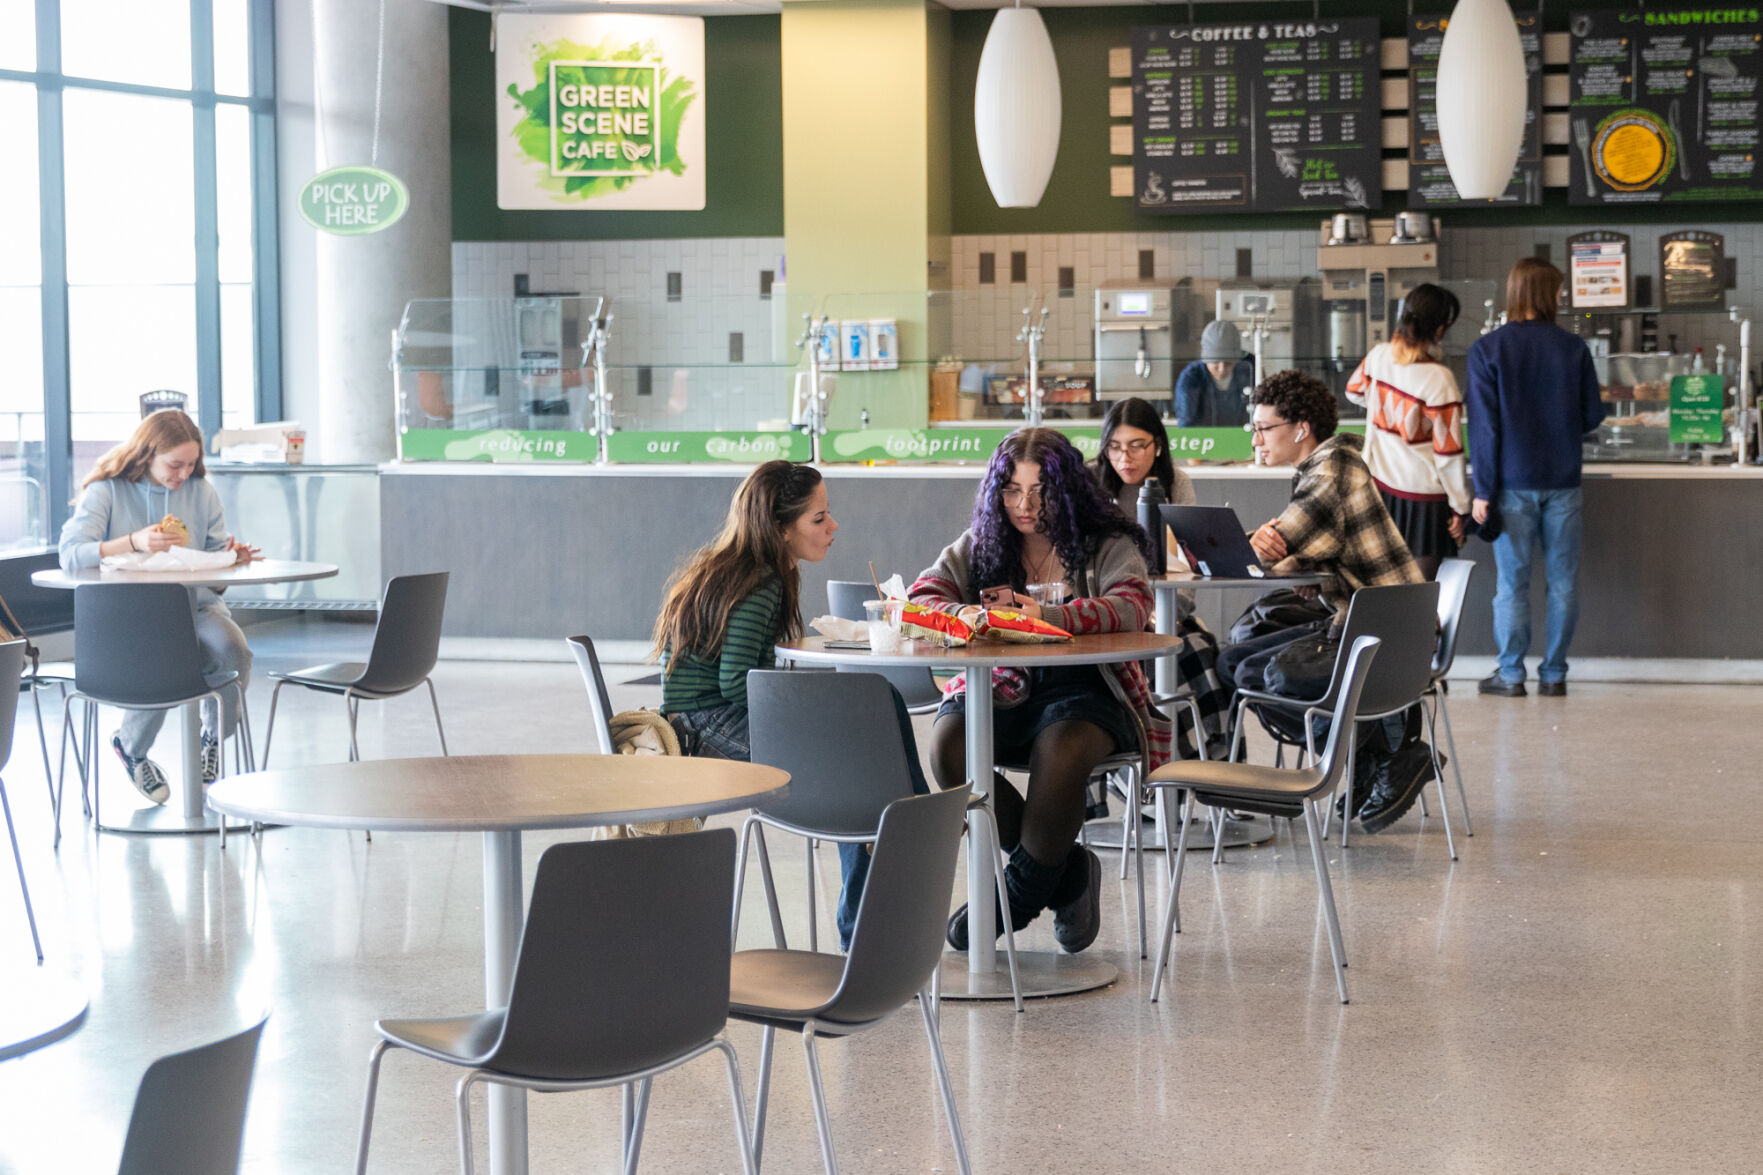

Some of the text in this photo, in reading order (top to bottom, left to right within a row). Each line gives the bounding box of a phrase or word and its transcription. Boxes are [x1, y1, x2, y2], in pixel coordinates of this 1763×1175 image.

[1644, 9, 1759, 25] SANDWICHES
[1191, 24, 1317, 41] COFFEE & TEAS
[560, 84, 650, 108] GREEN
[561, 111, 649, 135] SCENE
[562, 140, 618, 159] CAFE
[312, 182, 391, 204] PICK UP
[325, 204, 379, 225] HERE
[480, 437, 567, 457] reducing
[646, 440, 680, 453] our
[705, 437, 776, 453] carbon
[886, 435, 981, 456] footprint
[1170, 436, 1215, 455] step
